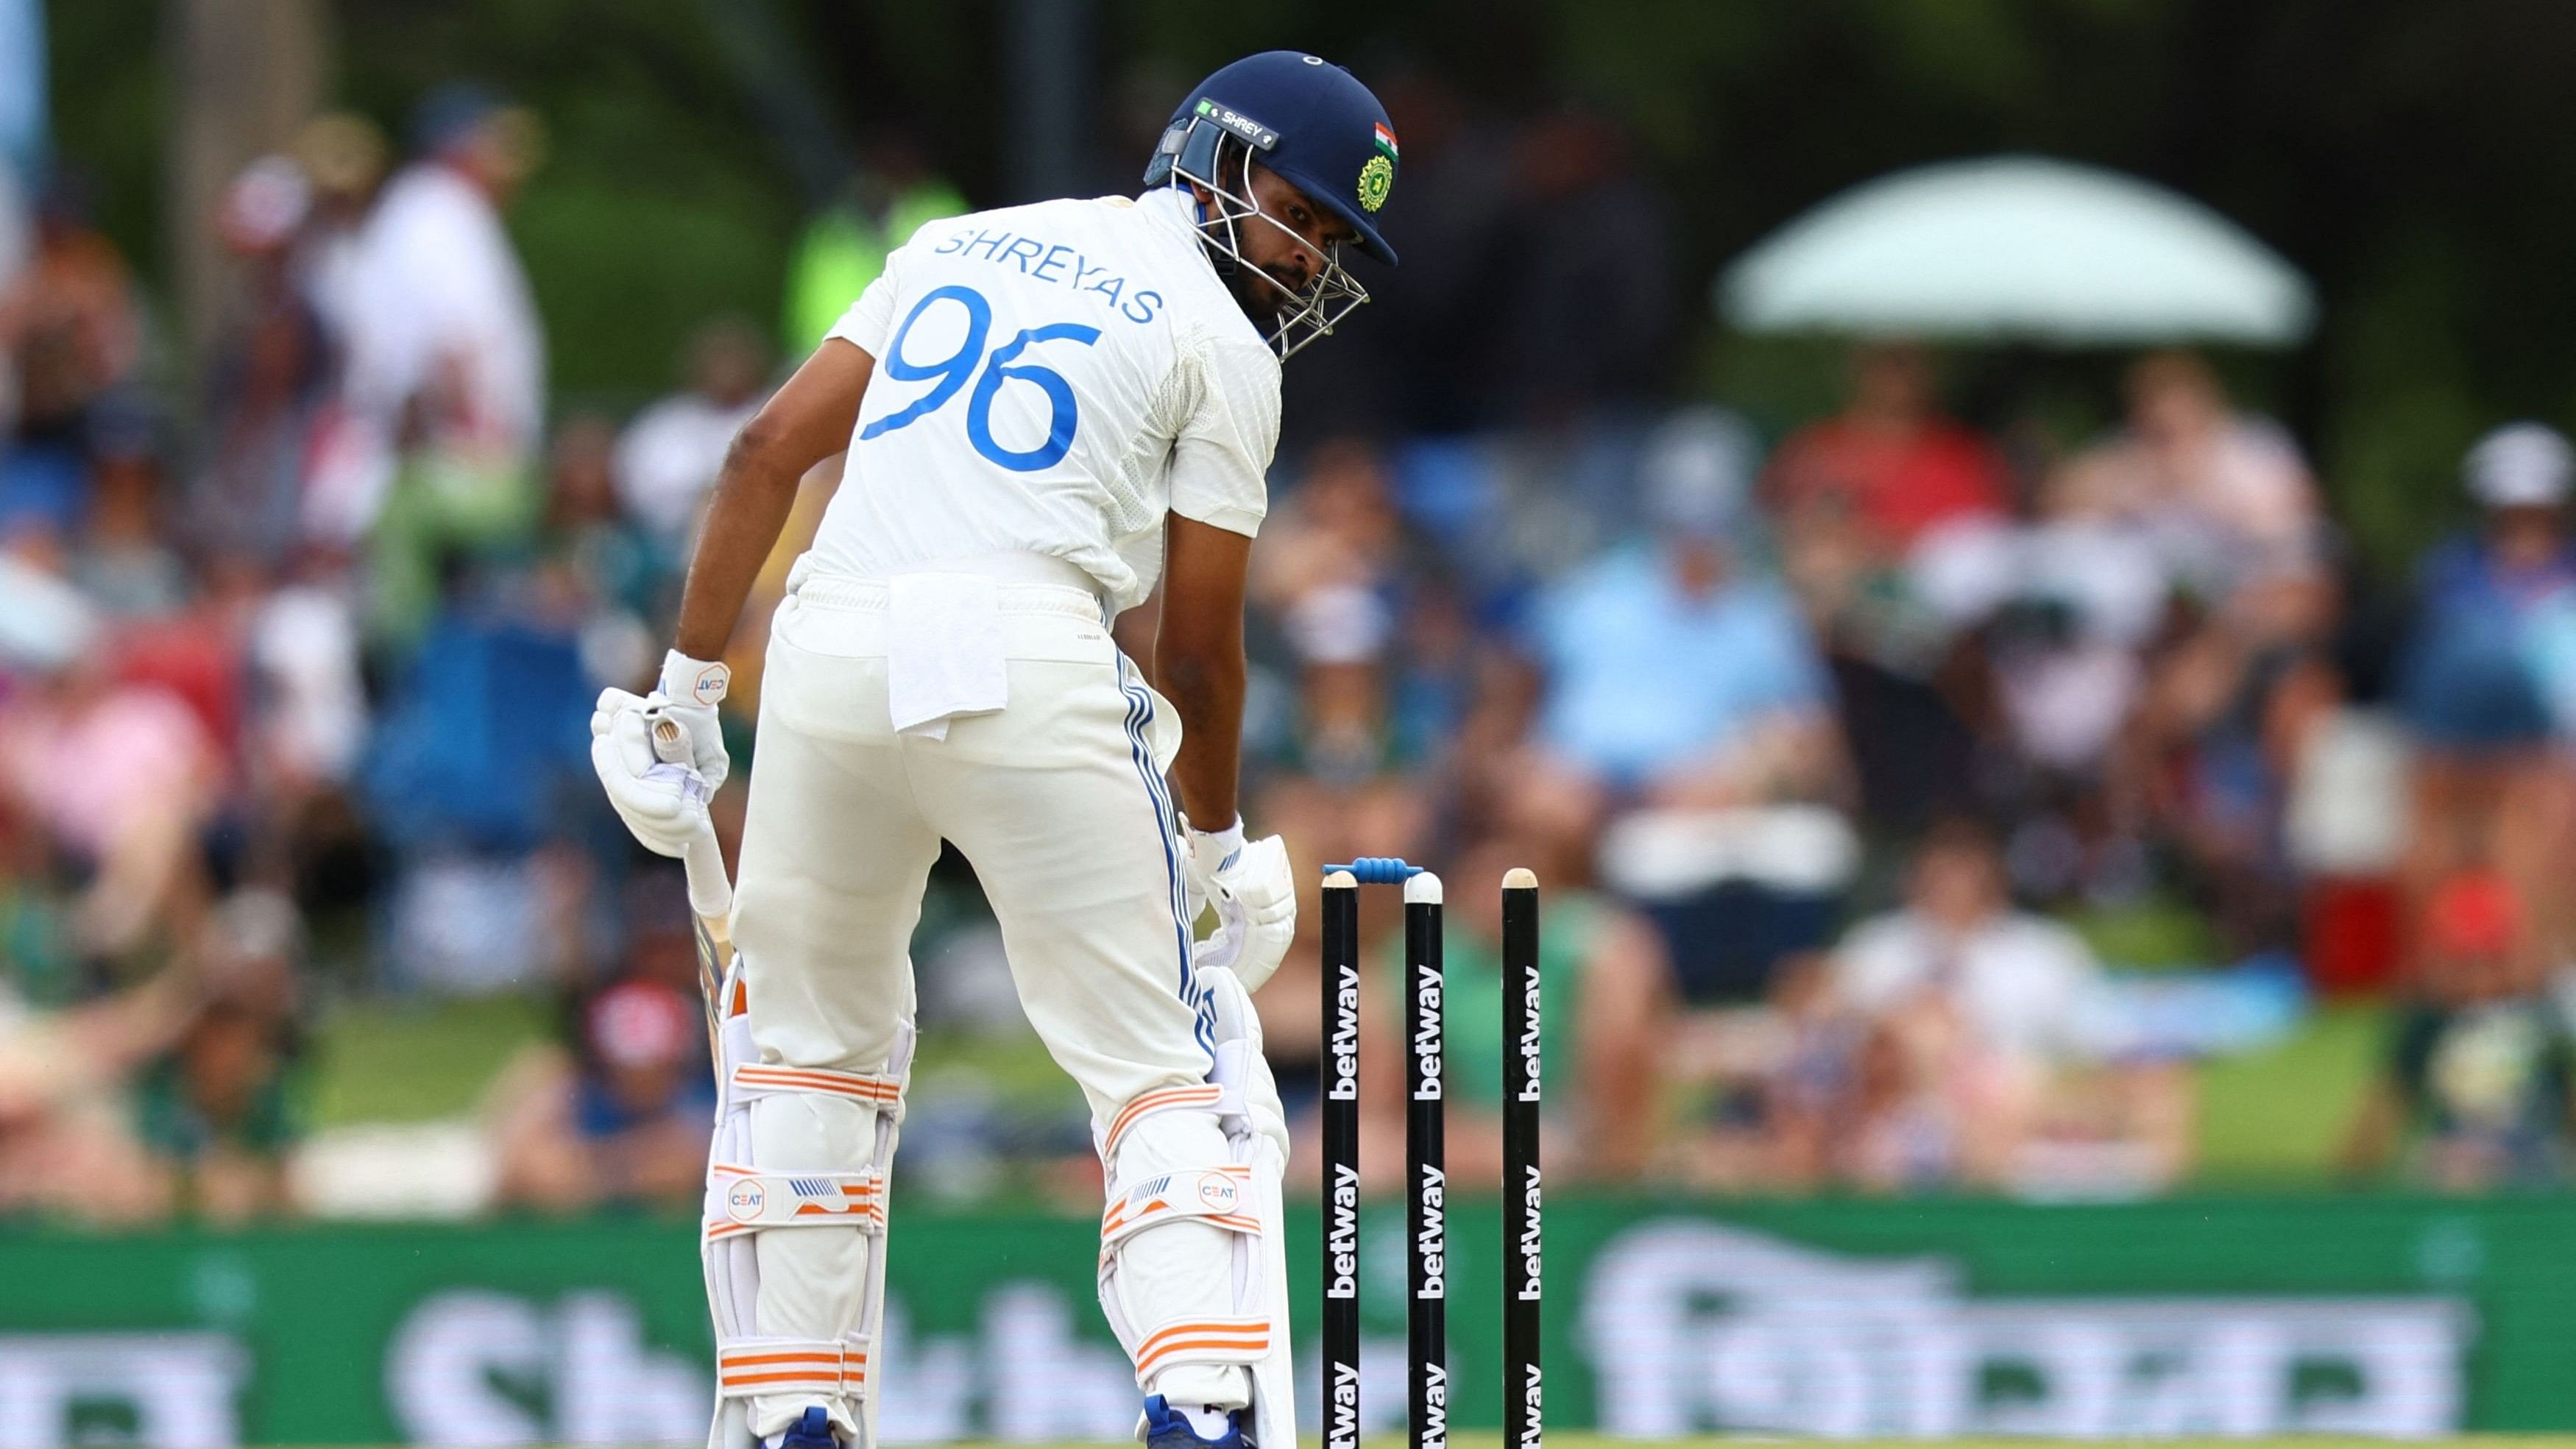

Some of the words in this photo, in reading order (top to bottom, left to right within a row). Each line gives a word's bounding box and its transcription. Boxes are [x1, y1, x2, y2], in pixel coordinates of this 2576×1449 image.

[1222, 111, 1262, 137] SHREY
[934, 229, 1163, 324] SHREYAS
[860, 285, 1103, 472] 96
[698, 679, 724, 690] CEAT
[1329, 964, 1359, 1100] betway
[1414, 964, 1443, 1100] betway
[1518, 966, 1540, 1102] betway
[732, 1194, 762, 1206] CEAT
[1202, 1186, 1234, 1199] CEAT
[1327, 1163, 1359, 1299] betway
[1418, 1163, 1445, 1299] betway
[1518, 1164, 1542, 1300] betway
[1329, 1361, 1359, 1449] tway
[1422, 1362, 1446, 1449] tway
[1521, 1363, 1543, 1449] tway
